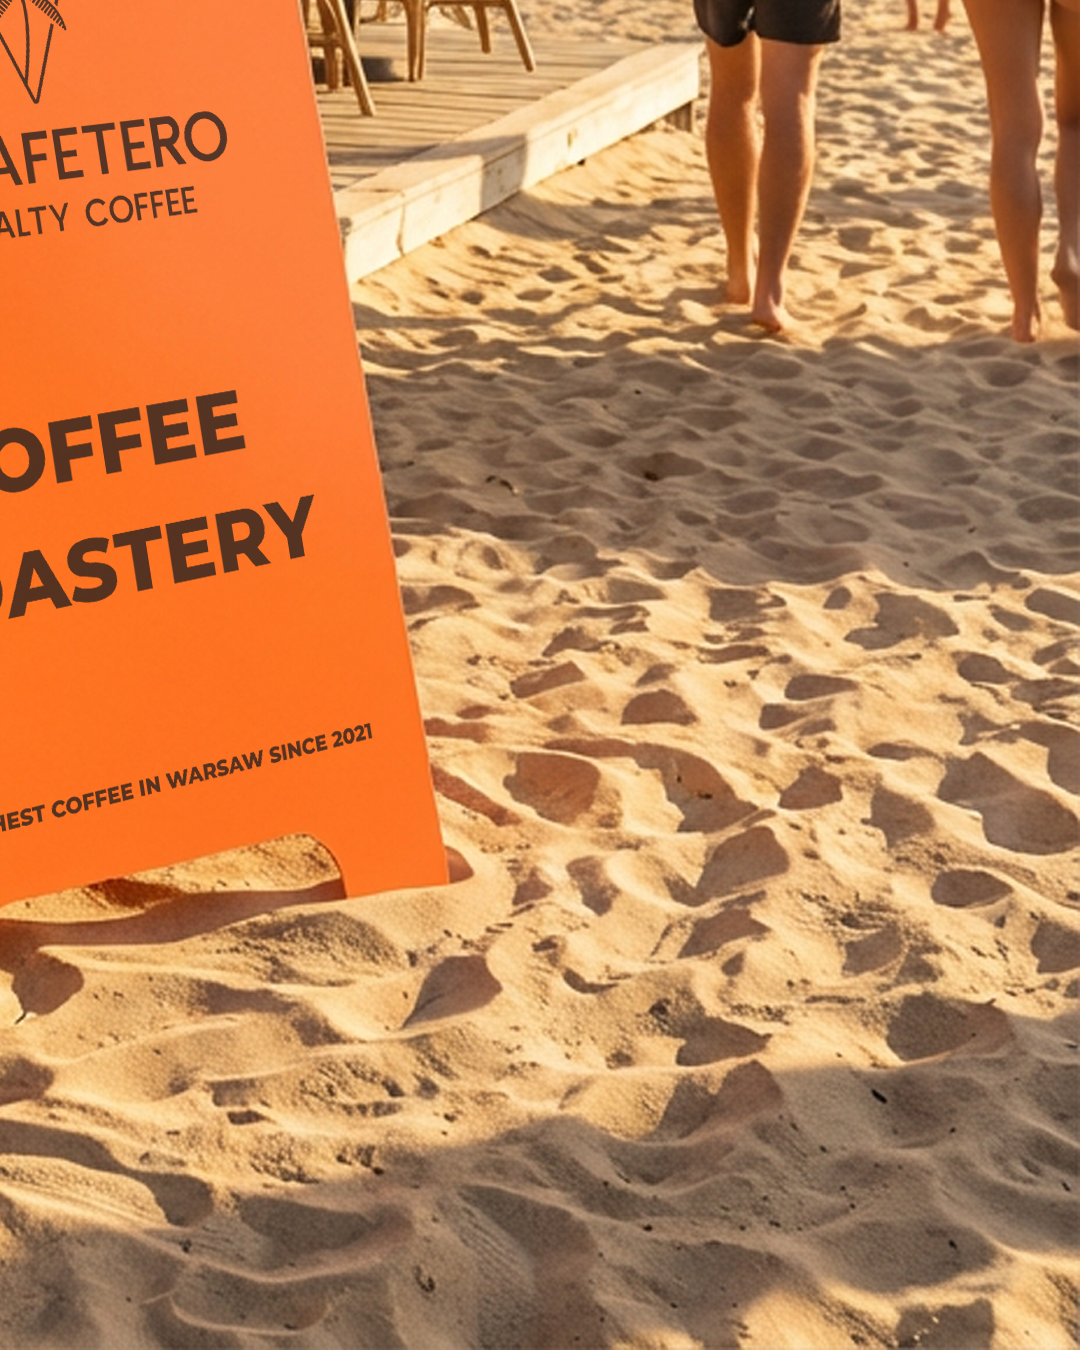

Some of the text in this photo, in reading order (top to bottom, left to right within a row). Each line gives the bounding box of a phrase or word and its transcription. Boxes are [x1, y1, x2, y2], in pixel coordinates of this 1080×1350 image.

[85, 185, 198, 227] COFFEE
[51, 782, 135, 818] COFFEE
[138, 775, 161, 797] IN
[165, 749, 263, 789] WARSAW
[269, 734, 328, 764] SINCE
[331, 722, 373, 748] 2021
